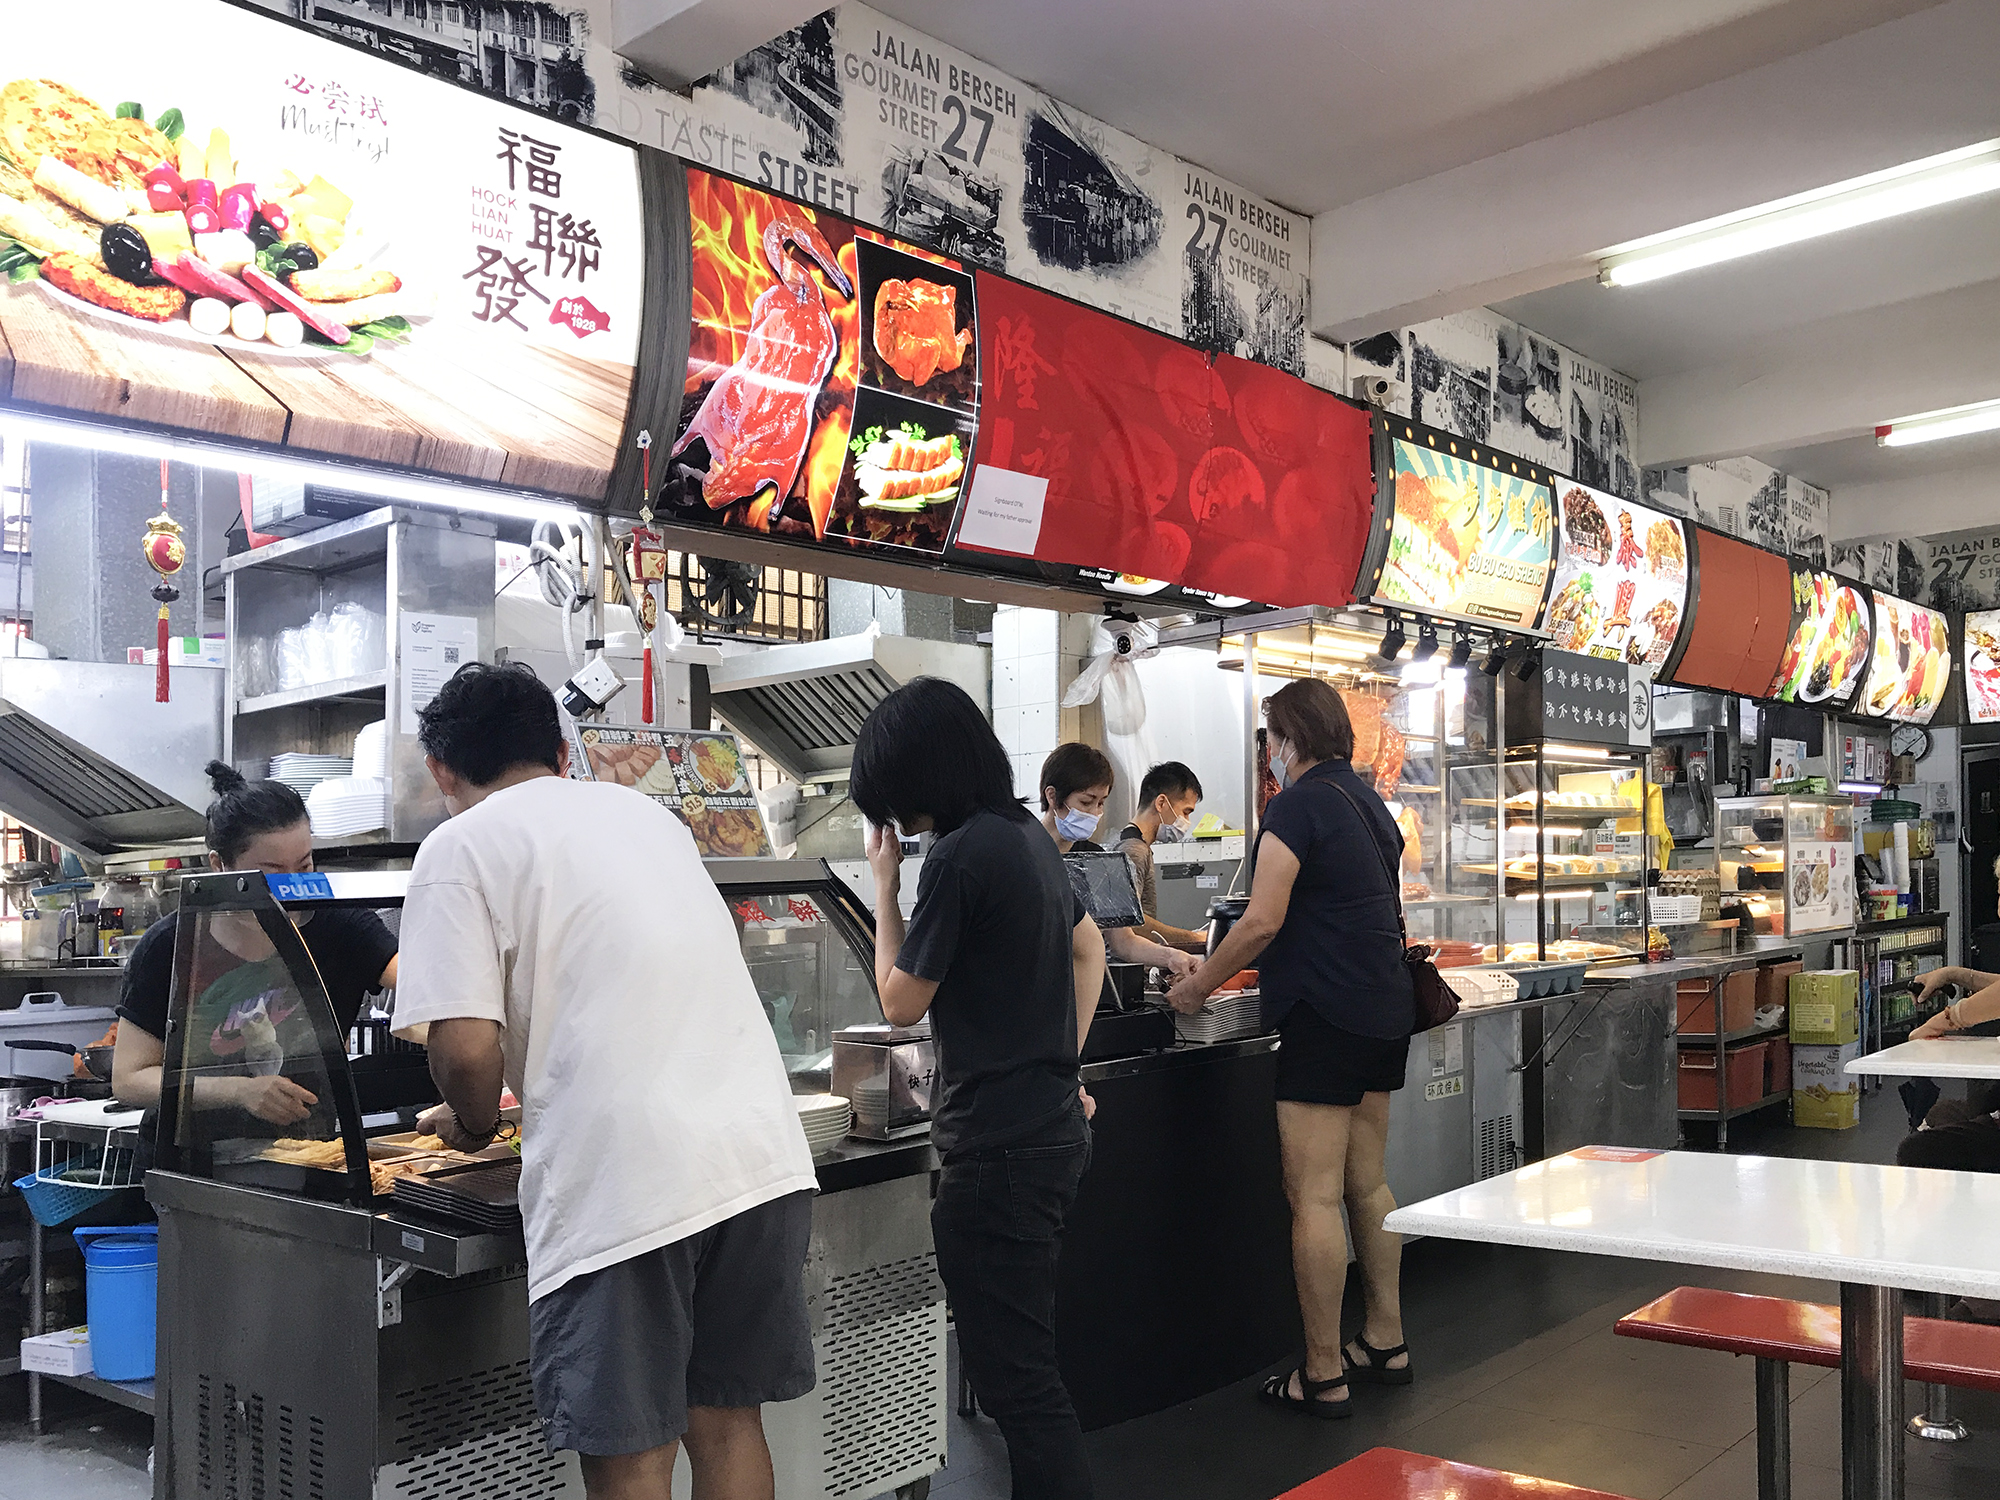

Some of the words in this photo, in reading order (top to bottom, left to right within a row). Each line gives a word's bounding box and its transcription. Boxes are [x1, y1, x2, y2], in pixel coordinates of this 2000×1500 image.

[844, 53, 938, 114] GOURMET
[872, 30, 940, 84] JALAN
[949, 64, 1016, 119] BERSEH
[879, 98, 938, 143] STREET
[942, 94, 994, 168] 27
[655, 107, 747, 178] TASTE
[757, 150, 859, 219] STREET
[471, 186, 517, 211] HOCK
[1184, 172, 1234, 215] JALAN
[1240, 199, 1289, 242] BERSEH
[472, 203, 508, 225] LIAN
[462, 126, 602, 332] 福聯發
[472, 221, 513, 243] HUAT
[1186, 203, 1227, 261] 27
[1229, 227, 1291, 271] GOURMET
[570, 316, 596, 332] 1928
[1569, 360, 1601, 393] JALAN
[1603, 375, 1635, 408] BERSEH
[994, 497, 1013, 506] Signboard
[977, 508, 993, 518] Waiting
[1006, 513, 1017, 521] father
[1930, 539, 1984, 558] JALAN
[1096, 570, 1112, 581] Noodle
[1483, 556, 1497, 577] BU
[1515, 565, 1544, 588] SHENG
[1930, 553, 1977, 590] 27
[583, 731, 598, 746] $2.5
[704, 782, 716, 794] $5
[684, 797, 703, 812] $1.5
[277, 883, 326, 898] PULL
[1796, 1059, 1827, 1069] Vegetable
[907, 1068, 934, 1090] 筷子
[1427, 1080, 1452, 1098] 环戊烷
